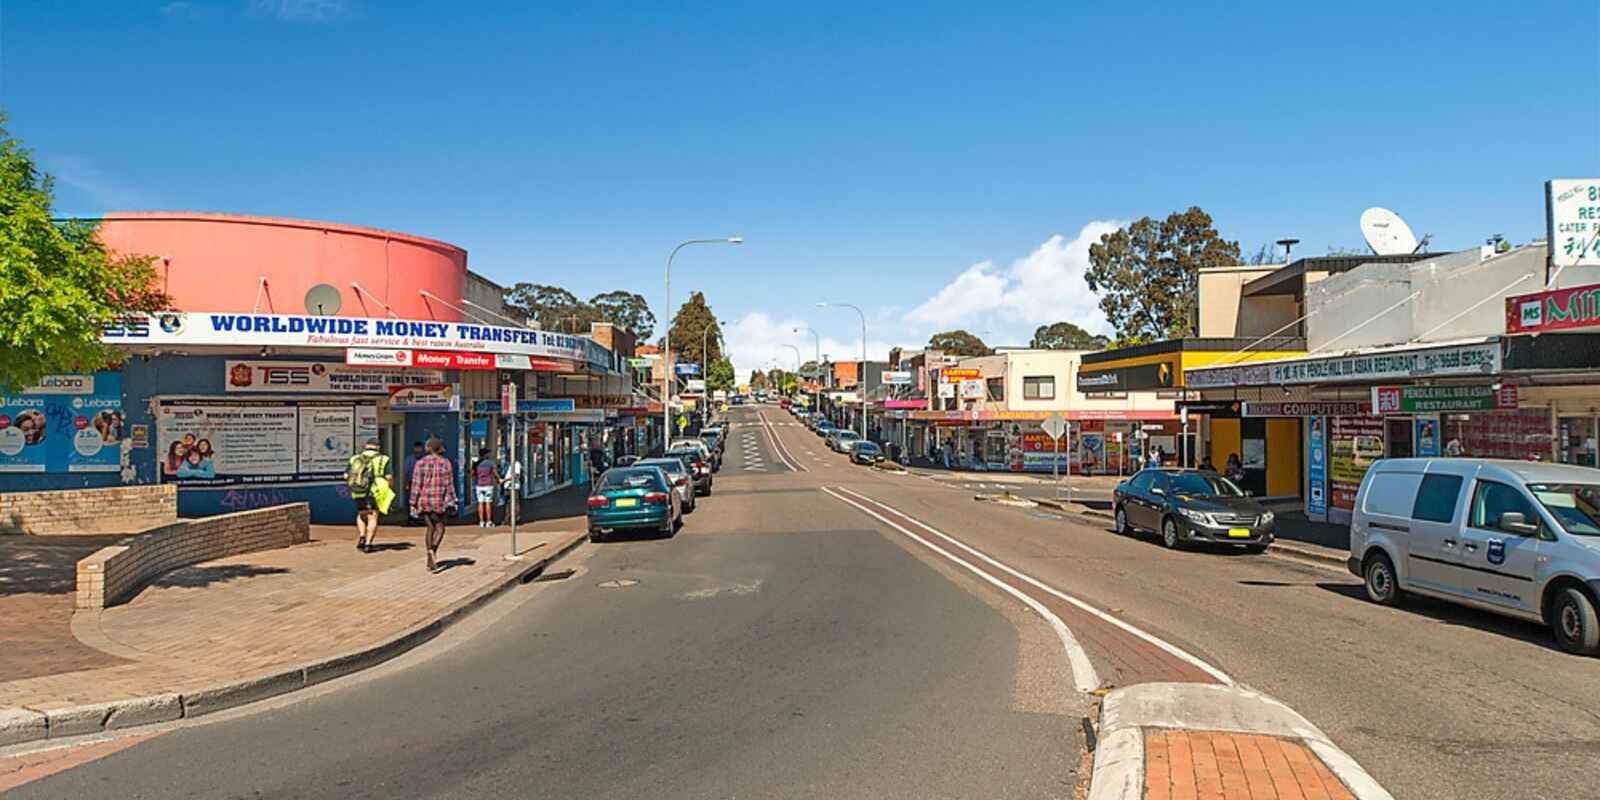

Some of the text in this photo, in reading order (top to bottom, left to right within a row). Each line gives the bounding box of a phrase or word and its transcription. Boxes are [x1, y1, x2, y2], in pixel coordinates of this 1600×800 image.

[1588, 186, 1600, 202] 8
[1559, 223, 1586, 232] CATER
[1523, 307, 1540, 320] MS
[210, 316, 368, 335] WORLDWIDE
[376, 321, 448, 338] MONEY
[457, 326, 537, 345] TRANSFER
[307, 335, 349, 345] Fabulous
[350, 337, 368, 347] fast
[371, 338, 401, 346] service
[417, 354, 450, 367] Money
[456, 355, 489, 366] Transfer
[1306, 361, 1328, 376] PENDLE
[1329, 360, 1341, 376] HILL
[1354, 358, 1373, 374] ASIAN
[1374, 354, 1418, 373] RESTAURANT
[257, 367, 309, 385] TSS
[329, 374, 383, 384] WORLDWIDE
[40, 378, 83, 388] Lebara
[1403, 388, 1433, 398] PENDLE
[1435, 388, 1453, 398] HILL
[1470, 387, 1492, 397] ASIAN
[7, 396, 44, 407] Lebara
[84, 398, 121, 408] Lebara
[1415, 400, 1481, 410] RESTAURANT
[1282, 403, 1356, 415] COMPUTERS
